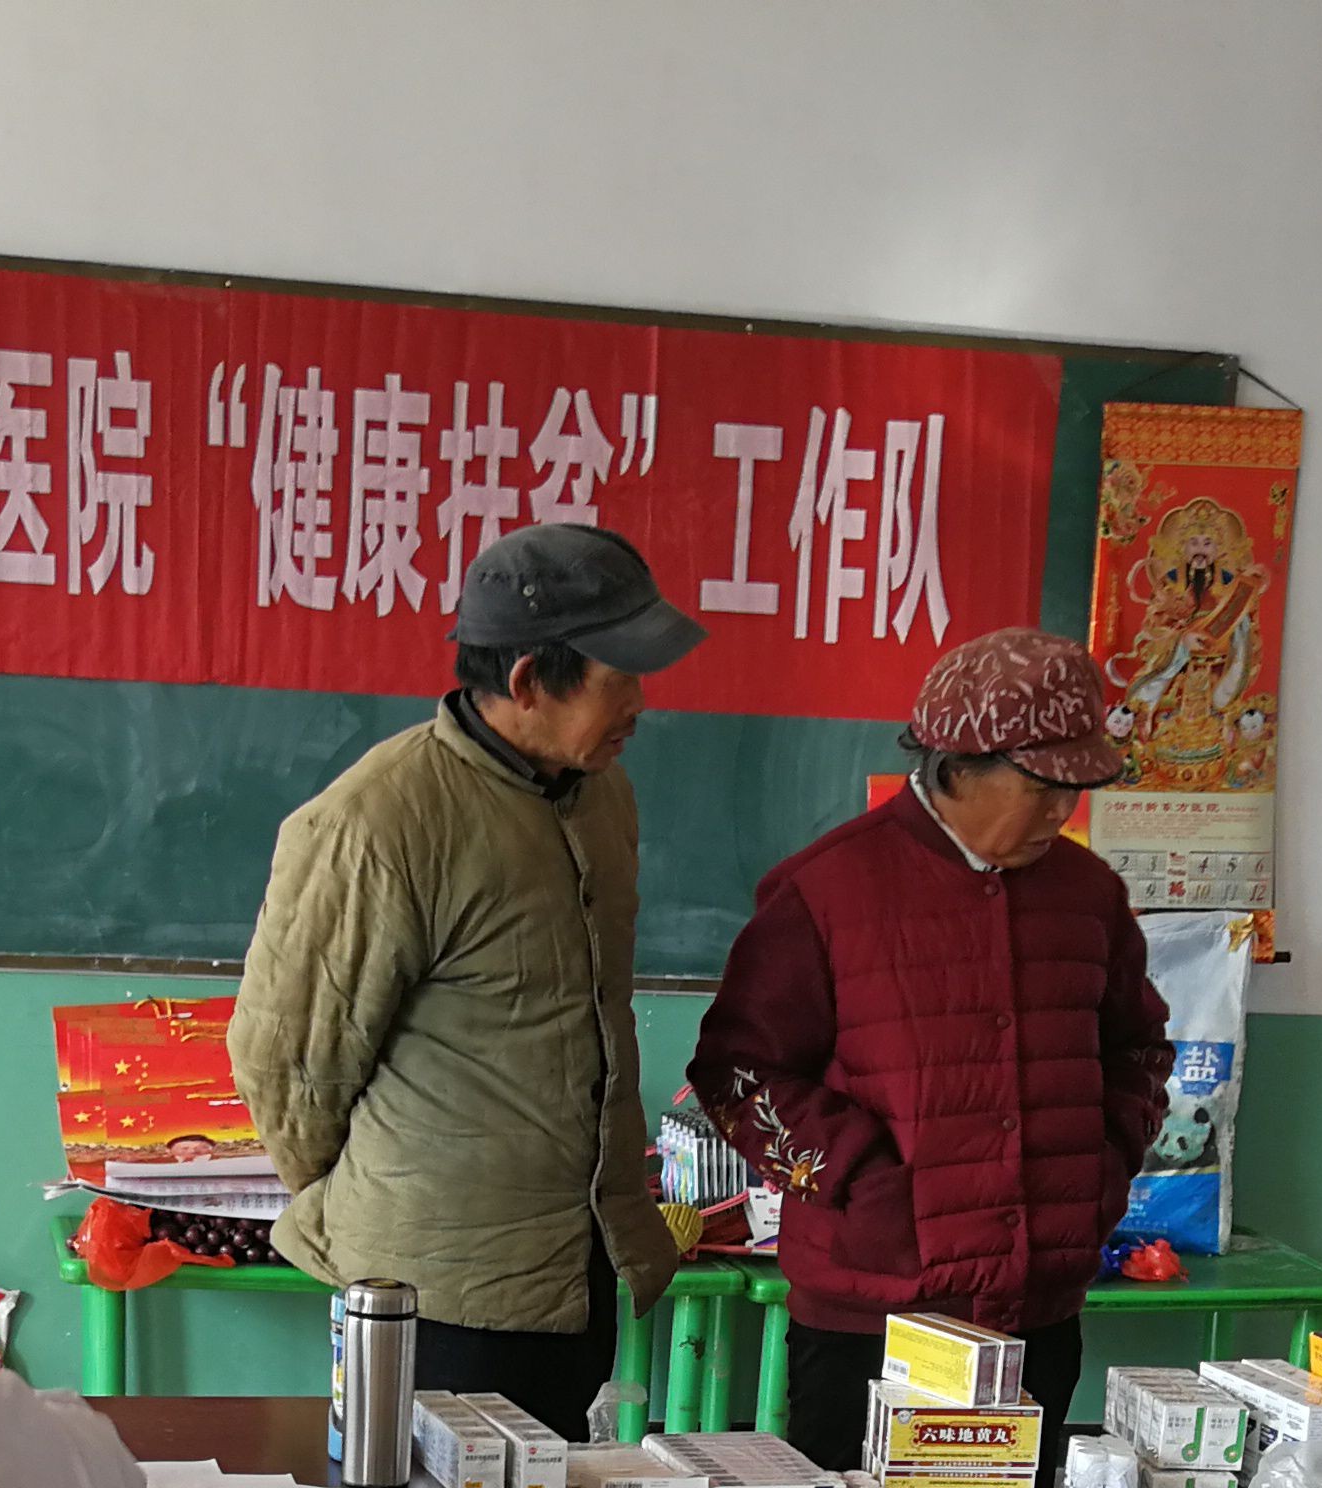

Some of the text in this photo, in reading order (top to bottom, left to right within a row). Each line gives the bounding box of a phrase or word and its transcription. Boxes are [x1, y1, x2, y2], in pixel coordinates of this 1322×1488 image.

[1249, 884, 1267, 902] 12
[1183, 1045, 1220, 1083] 盐
[921, 1427, 1010, 1444] 六味地黄丸
